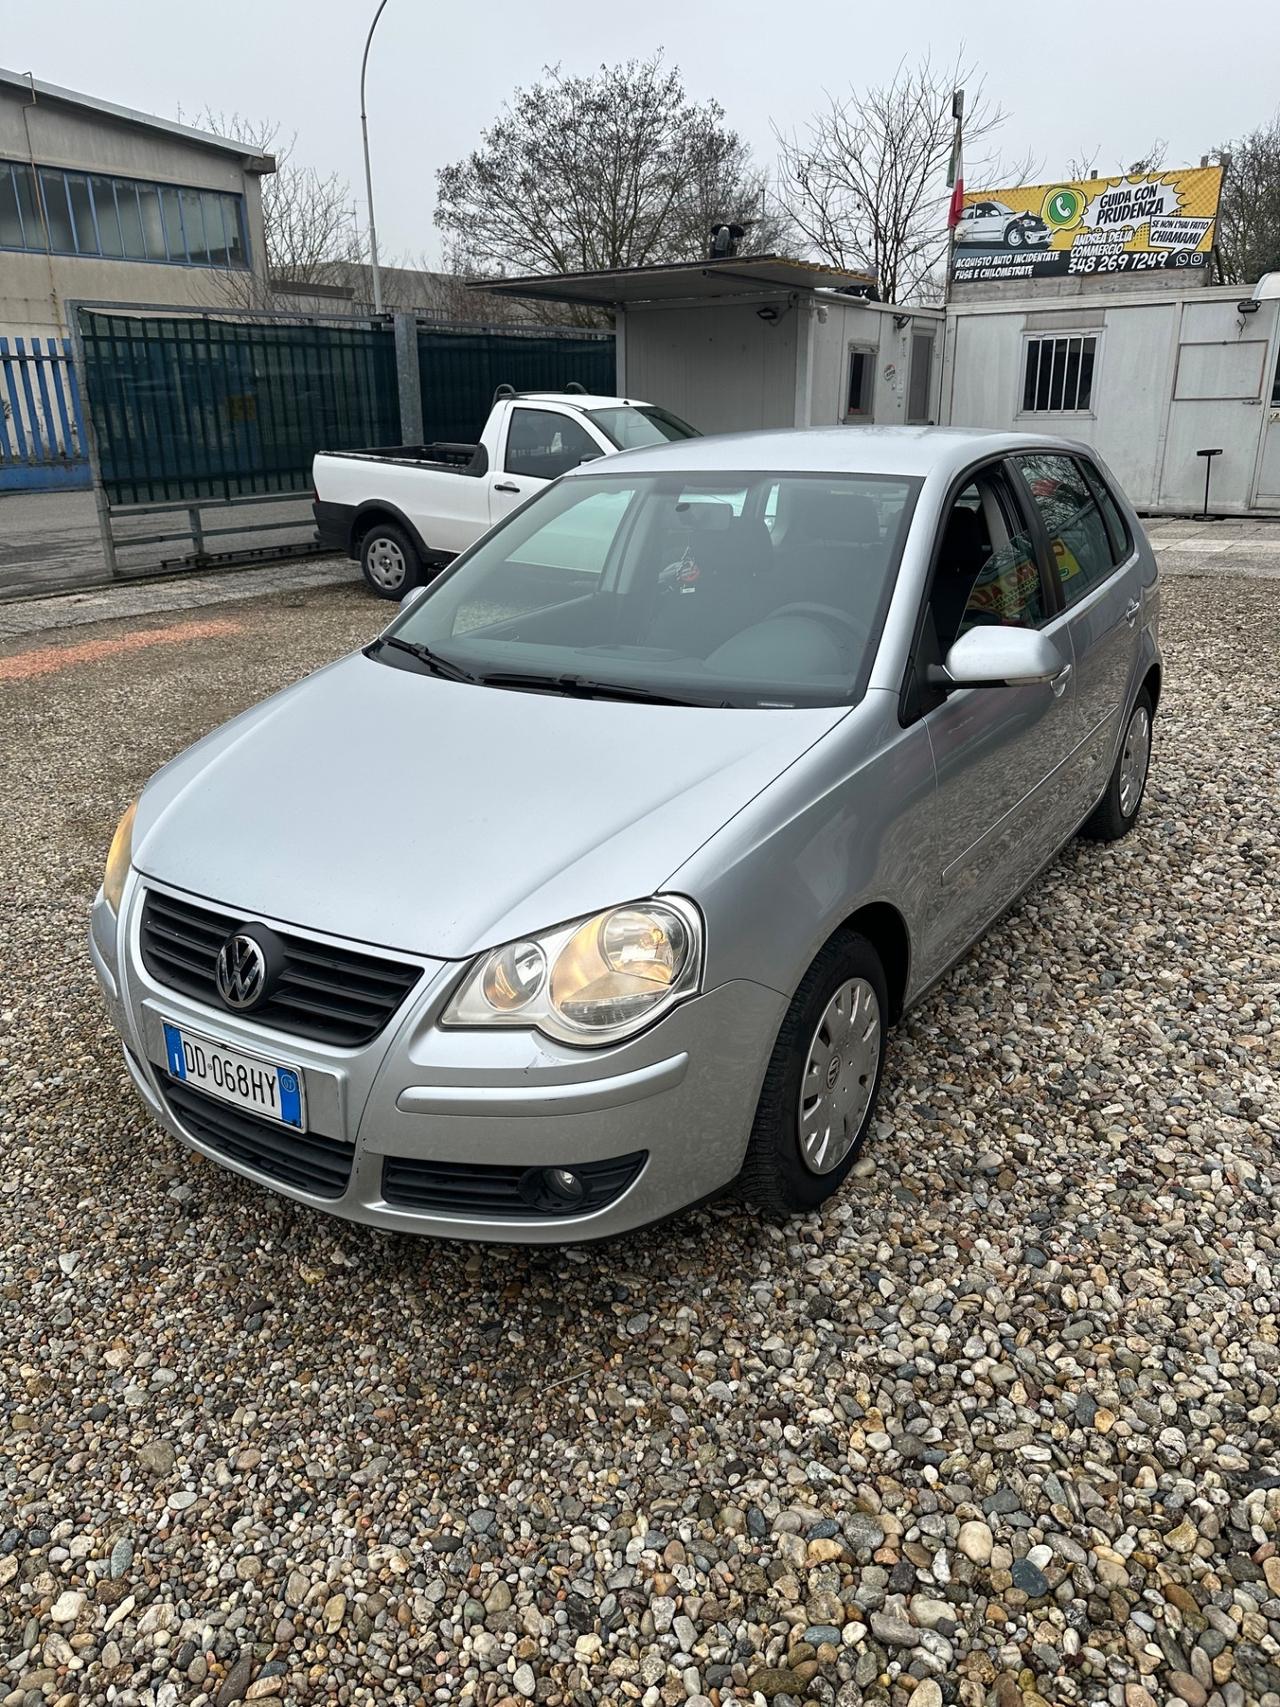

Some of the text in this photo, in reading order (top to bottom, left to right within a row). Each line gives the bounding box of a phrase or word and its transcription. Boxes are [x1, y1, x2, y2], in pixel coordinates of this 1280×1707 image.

[1100, 184, 1158, 209] GUIDA CON
[1096, 198, 1164, 225] PRUDENZA
[1152, 219, 1159, 228] SE
[1160, 220, 1174, 229] NON
[1189, 221, 1209, 230] FATTO
[1073, 232, 1106, 246] ANDREA
[1150, 230, 1202, 245] CHIAMAMI
[1070, 242, 1124, 257] COMMERCIO
[955, 251, 1061, 268] ACQUISTO AUTO INCIDENTATE
[1068, 251, 1169, 274] 348 269 7249
[954, 265, 1034, 280] FUSE E CHILOMETRATE
